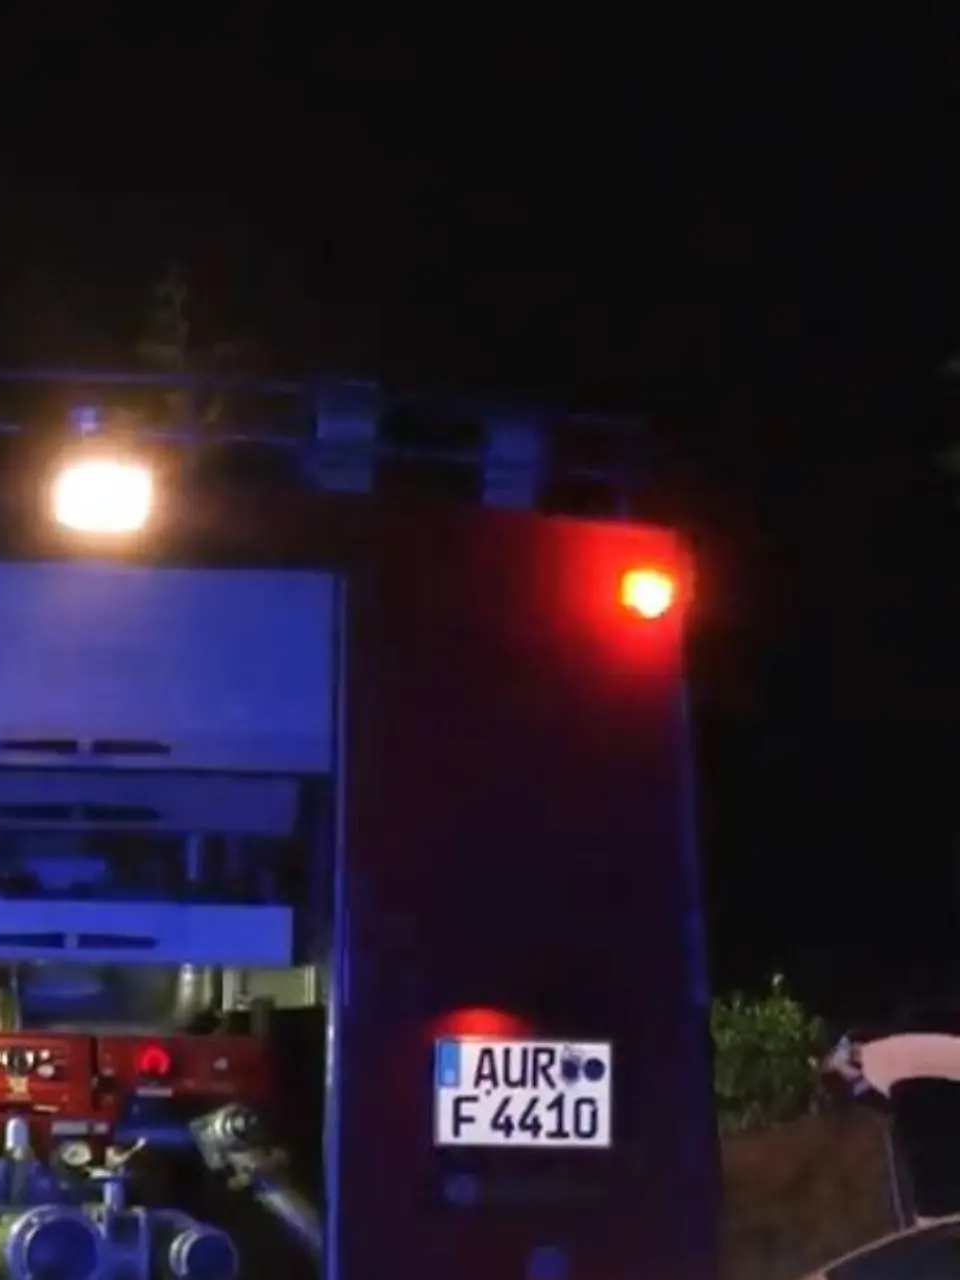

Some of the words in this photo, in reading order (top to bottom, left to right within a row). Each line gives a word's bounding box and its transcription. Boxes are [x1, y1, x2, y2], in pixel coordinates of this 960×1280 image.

[474, 1047, 557, 1088] AUR
[452, 1095, 480, 1138] F
[490, 1092, 598, 1139] 4410
